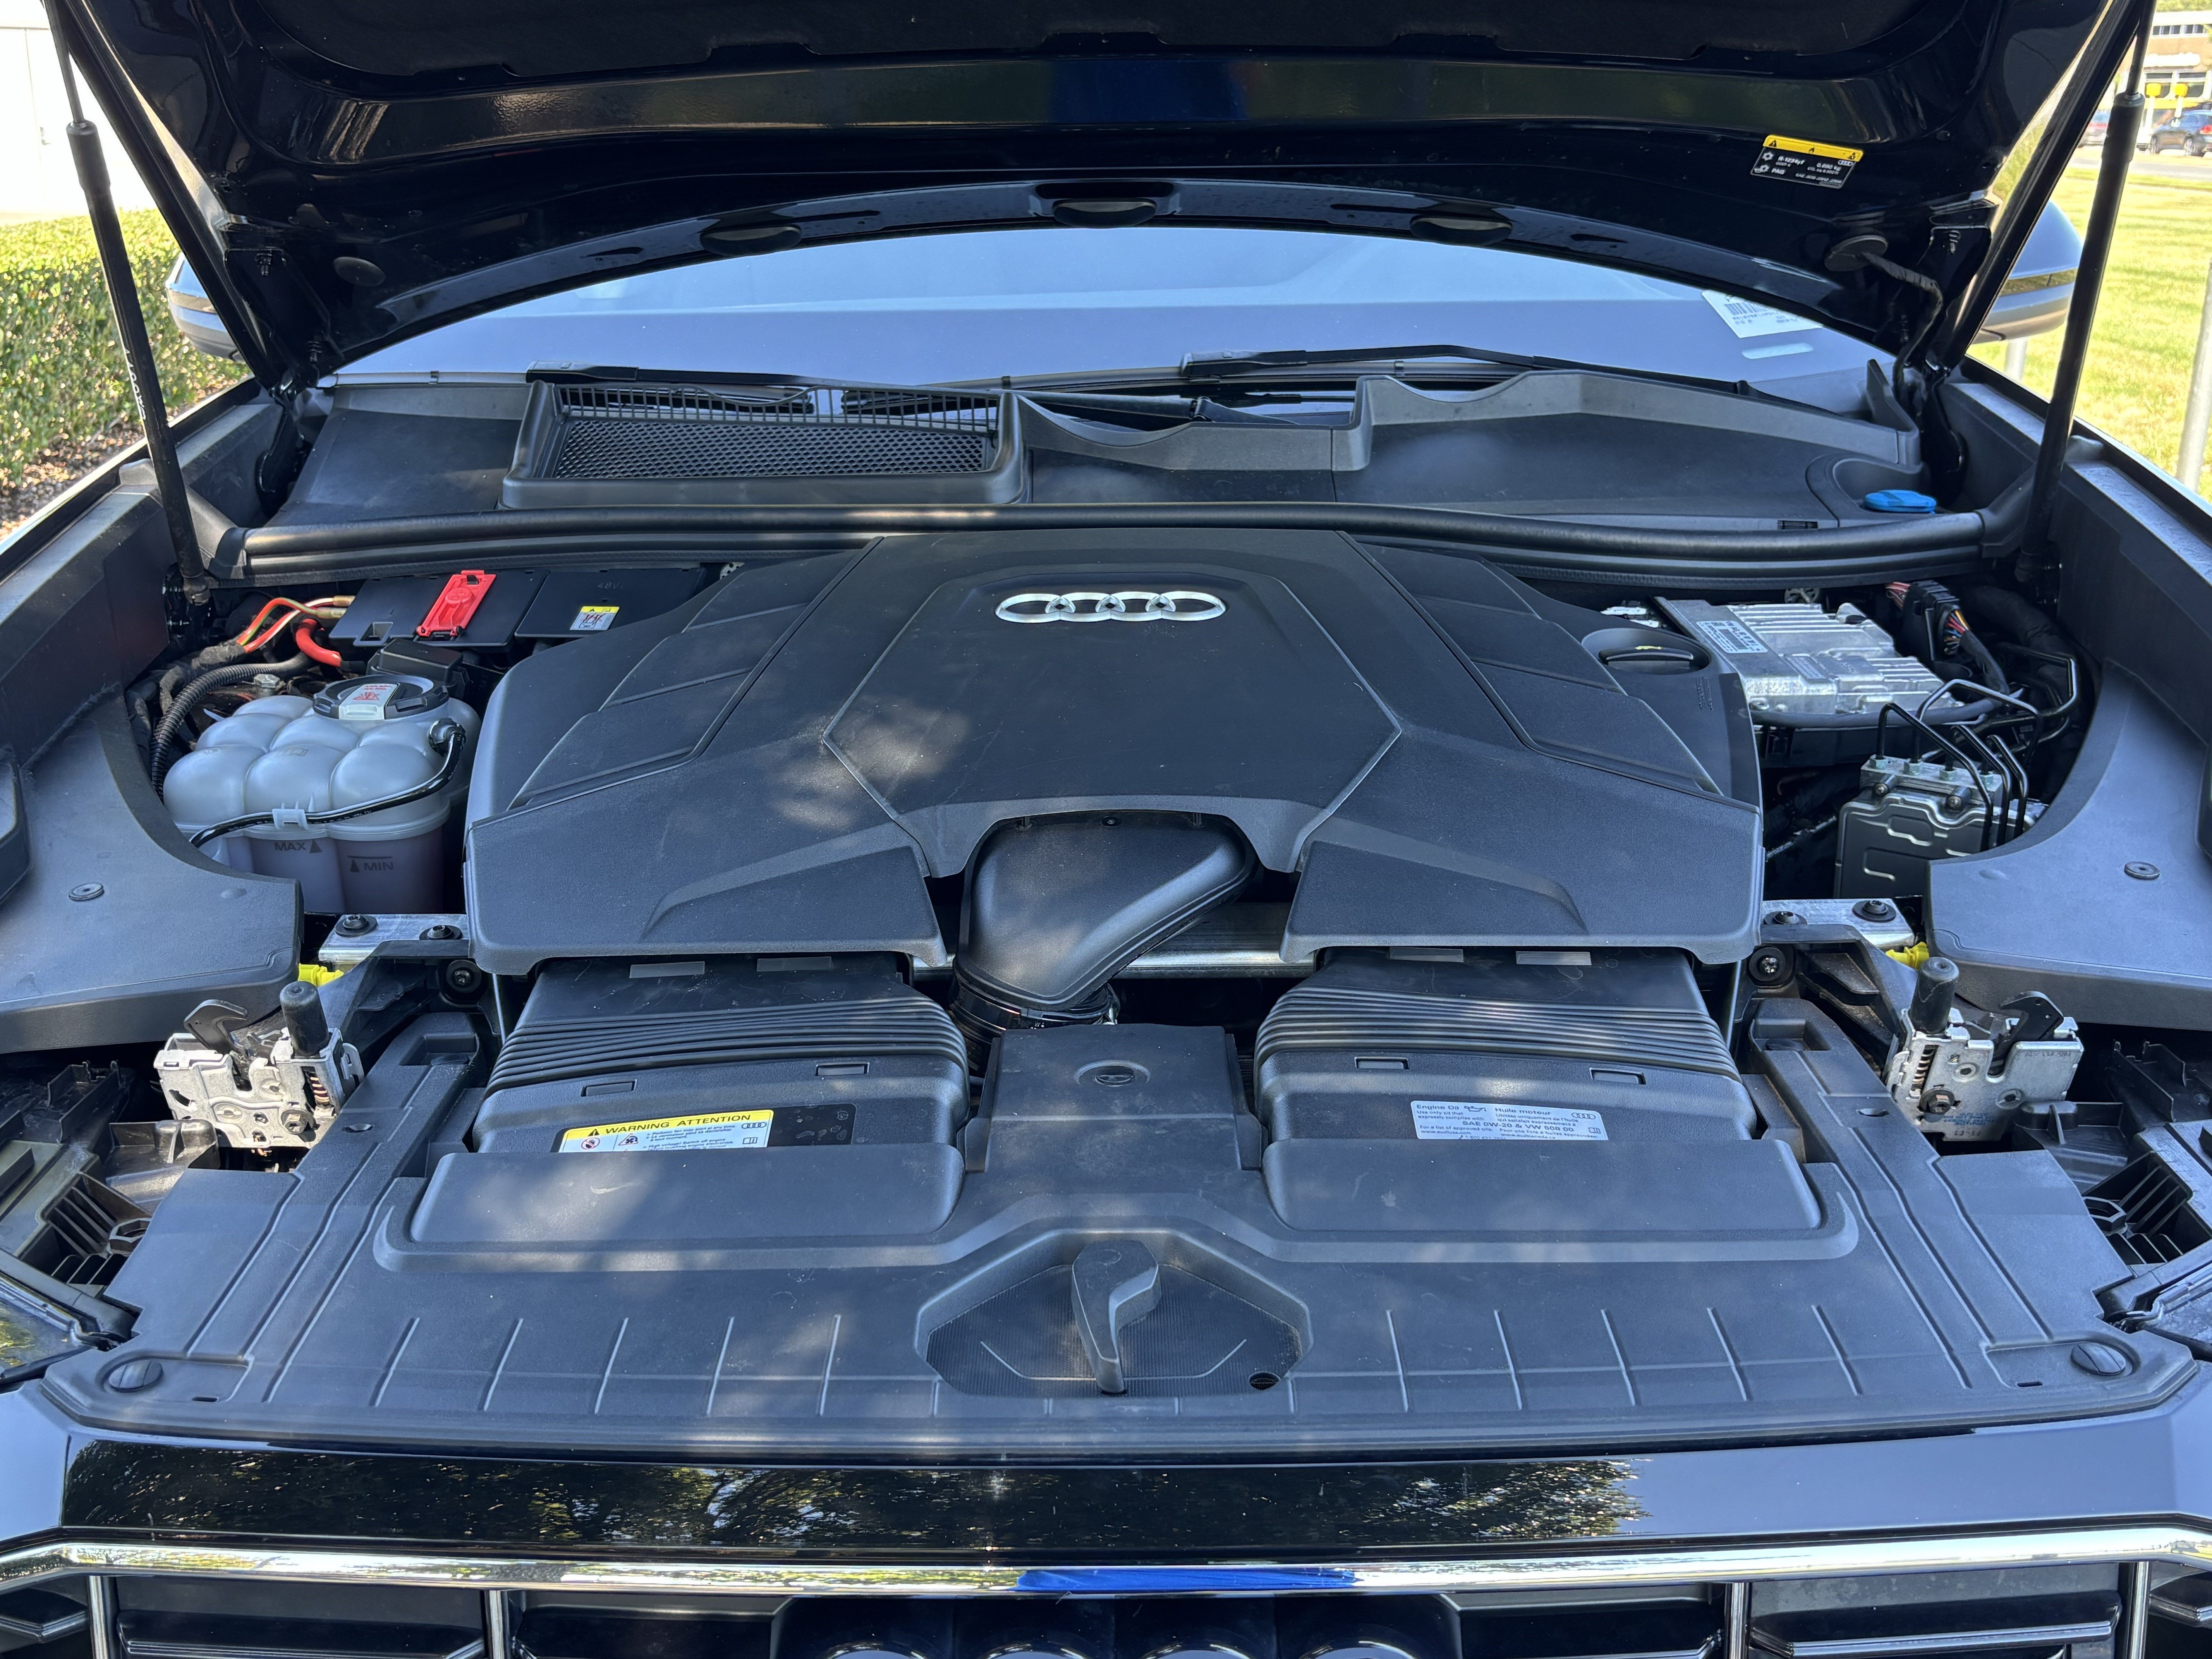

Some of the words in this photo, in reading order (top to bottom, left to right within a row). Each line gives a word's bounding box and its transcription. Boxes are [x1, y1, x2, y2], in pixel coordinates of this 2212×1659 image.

[274, 842, 306, 851] MAX
[364, 862, 394, 871] MIN
[606, 1122, 670, 1134] WARNING
[676, 1115, 750, 1126] ATTENTION
